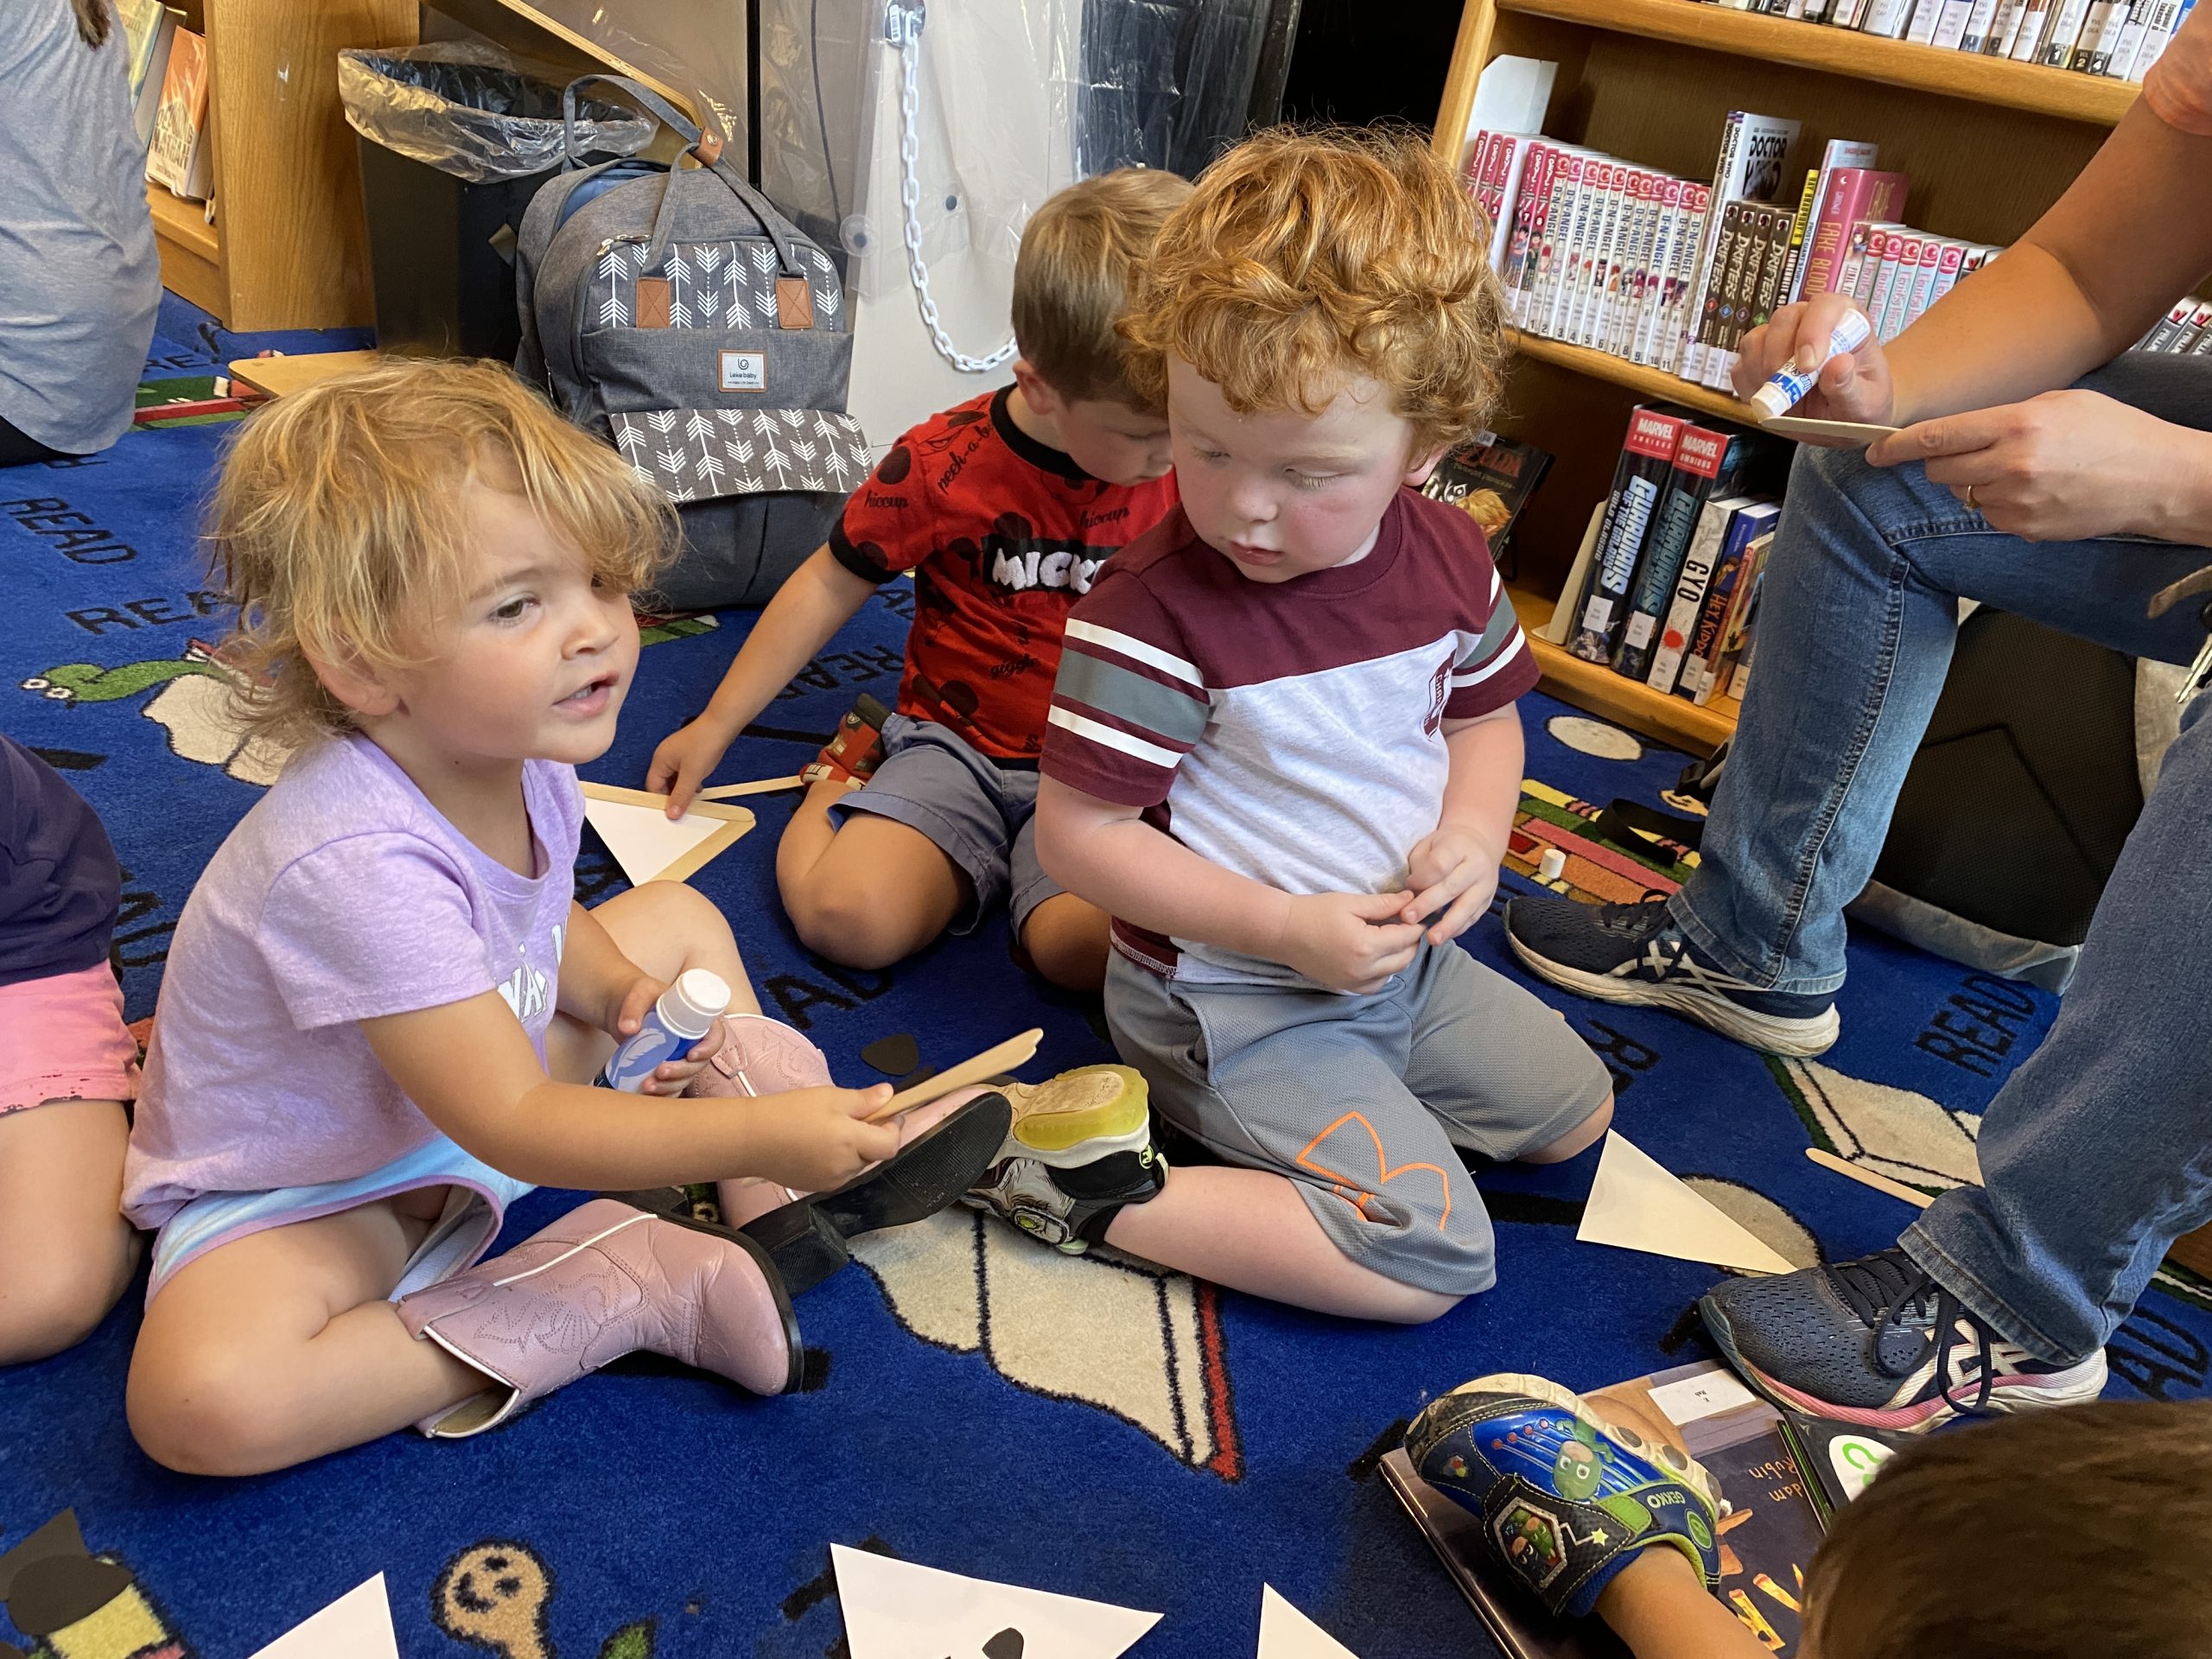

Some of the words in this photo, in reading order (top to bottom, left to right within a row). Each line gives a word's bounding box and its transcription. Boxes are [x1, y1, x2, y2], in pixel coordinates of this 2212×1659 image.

[2055, 51, 2061, 60] 1
[2076, 58, 2086, 67] 2
[2093, 60, 2101, 70] 4
[1722, 124, 1733, 154] DOCTOR
[1729, 127, 1740, 158] DOCTOR
[1749, 136, 1788, 158] DOCTOR
[1725, 160, 1733, 179] WHO
[1806, 176, 1816, 191] RAY
[1804, 221, 1814, 242] FROST
[1817, 221, 1842, 255] FAKE
[1710, 226, 1734, 294] DRIFTERS
[1725, 232, 1750, 300] DRIFTERS
[1742, 235, 1767, 302] DRIFTERS
[1759, 240, 1785, 309] DRIFTERS
[1804, 257, 1833, 296] BLOOD
[1530, 320, 1535, 329] 1
[1541, 325, 1548, 334] 2
[1558, 328, 1563, 338] 3
[1569, 333, 1577, 341] 4
[1585, 334, 1591, 344] 5
[1599, 340, 1604, 348] 6
[1611, 344, 1617, 353] 7
[1623, 346, 1629, 355] 8
[1635, 352, 1641, 361] 9
[1650, 356, 1659, 365] 10
[1662, 359, 1671, 370] 11
[1637, 418, 1674, 439] MARVEL
[1633, 435, 1672, 448] OMNIBUS
[1682, 435, 1718, 457] MARVEL
[1680, 453, 1712, 469] OMNIBUS
[865, 489, 910, 509] hiccup
[1620, 490, 1634, 506] OF
[1080, 506, 1130, 530] hiccup
[1614, 505, 1630, 527] THE
[0, 497, 138, 565] READ
[1600, 475, 1657, 594] GUARDIANS
[1601, 525, 1624, 569] GALAXY
[1638, 487, 1699, 615] GUARDIANS
[993, 548, 1105, 594] MICK
[1677, 560, 1709, 602] GYO
[1914, 973, 2036, 1077] READ
[1748, 1455, 1795, 1480] Rubin
[1646, 1490, 1686, 1509] GEKKO
[1769, 1480, 1804, 1502] dam
